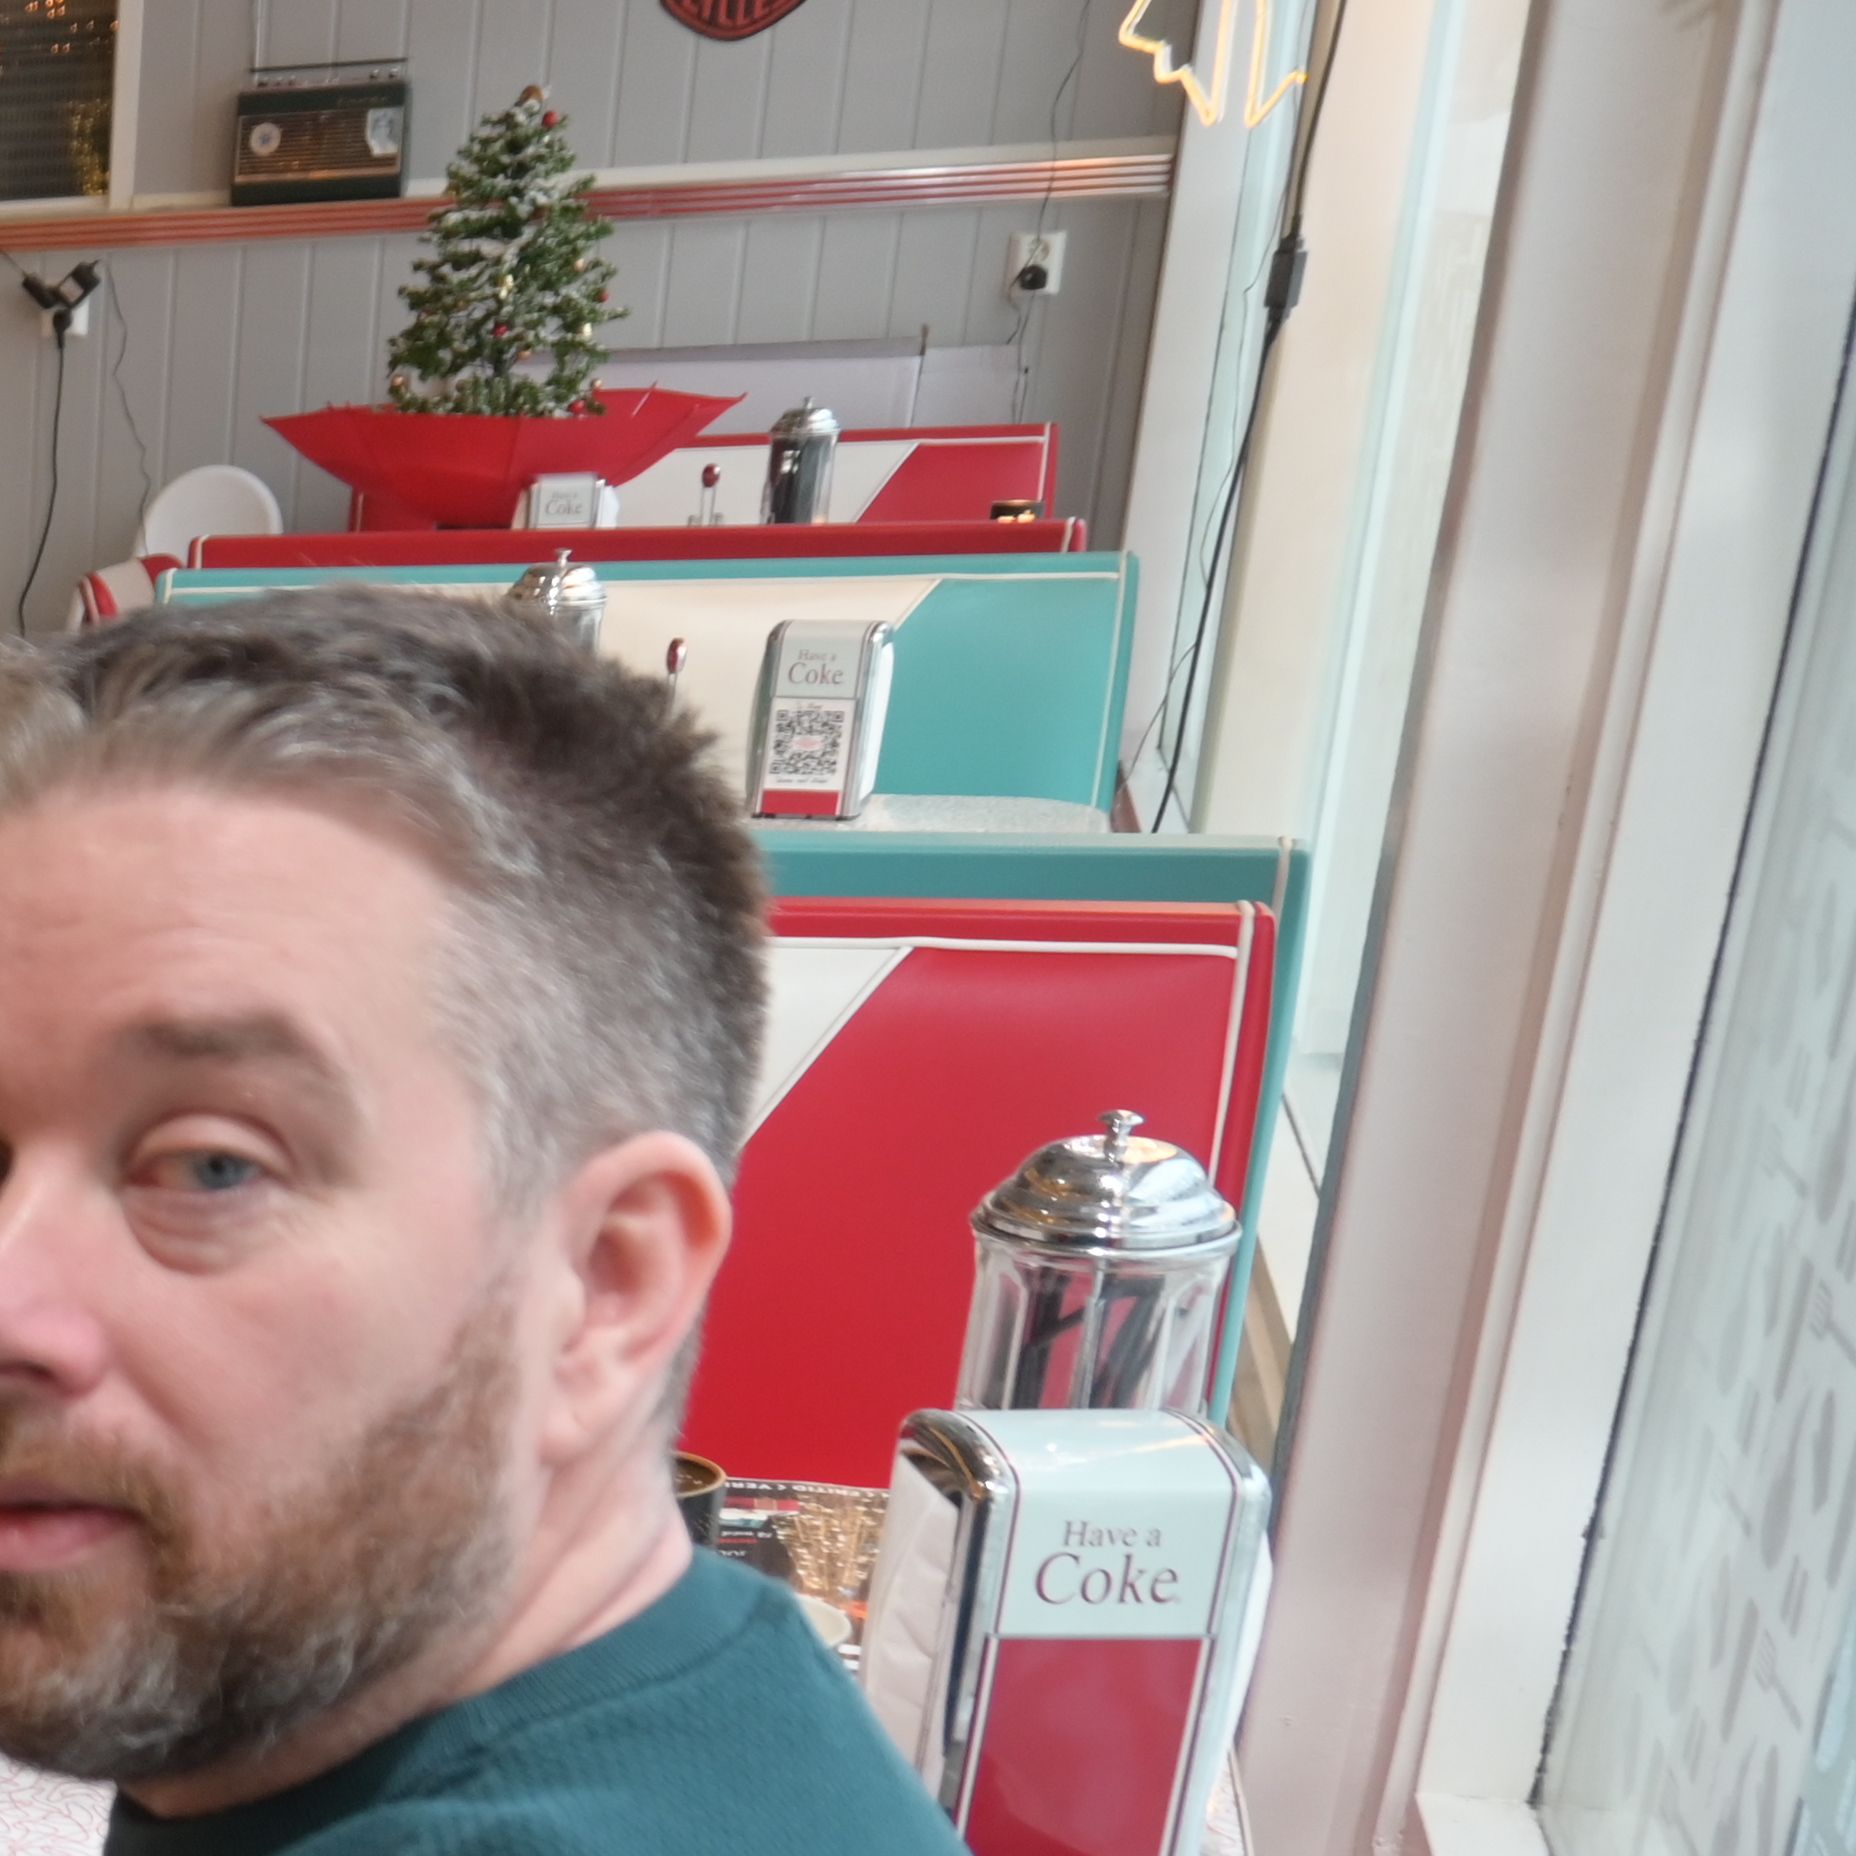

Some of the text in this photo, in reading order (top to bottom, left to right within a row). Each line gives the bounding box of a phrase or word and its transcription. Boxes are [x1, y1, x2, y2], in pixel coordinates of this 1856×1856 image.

[545, 500, 583, 515] Coke
[797, 650, 829, 661] Have
[789, 662, 845, 685] Coke
[1063, 1520, 1161, 1547] Have a
[1035, 1551, 1180, 1605] Coke
